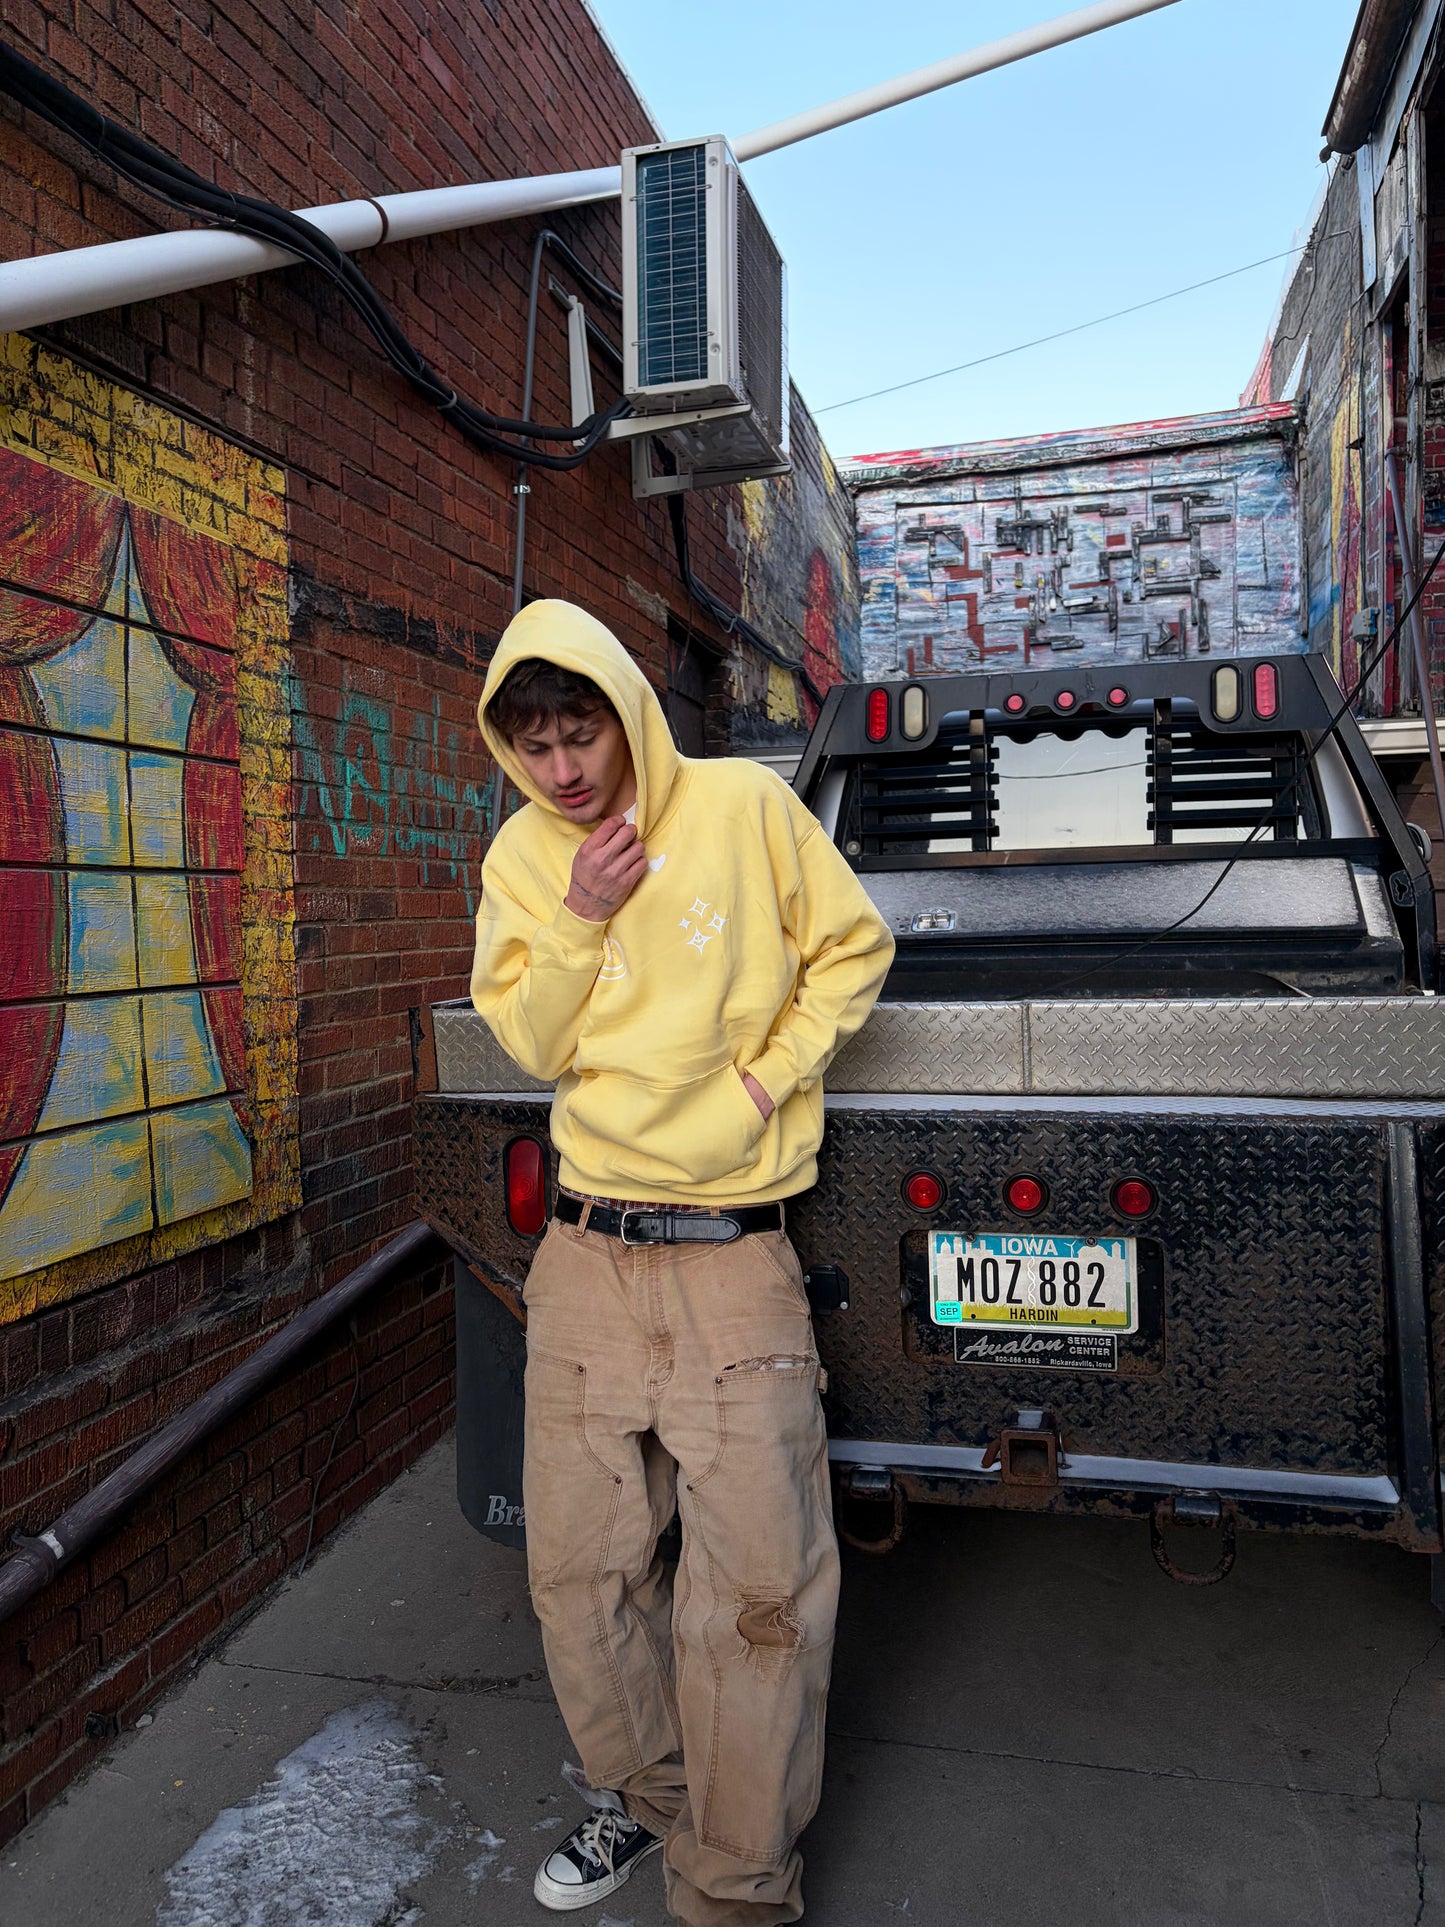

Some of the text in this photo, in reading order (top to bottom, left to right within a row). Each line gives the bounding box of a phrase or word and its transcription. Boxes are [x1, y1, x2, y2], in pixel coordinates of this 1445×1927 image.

[1001, 1237, 1058, 1256] IOWA
[956, 1257, 1106, 1308] MOZ 882
[940, 1307, 959, 1316] SEP
[1009, 1308, 1058, 1322] HARDIN
[959, 1333, 1065, 1360] Avalon
[1067, 1336, 1112, 1346] SERVICE
[1069, 1347, 1111, 1356] CENTER
